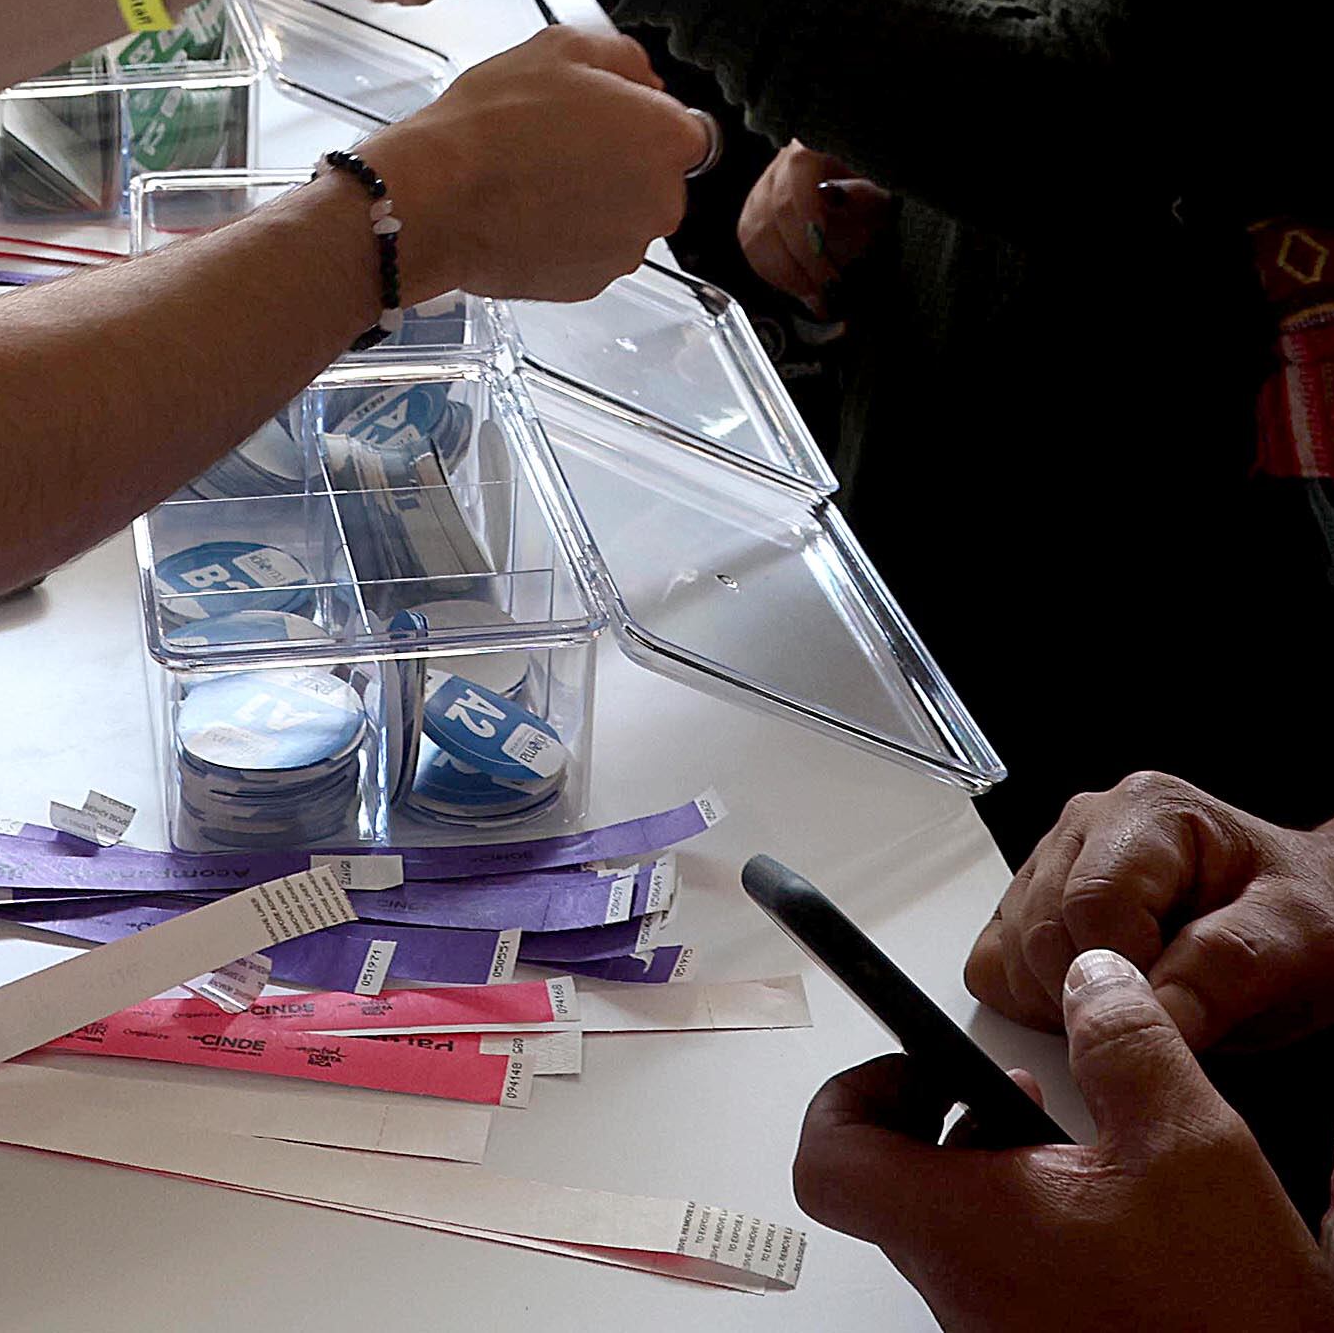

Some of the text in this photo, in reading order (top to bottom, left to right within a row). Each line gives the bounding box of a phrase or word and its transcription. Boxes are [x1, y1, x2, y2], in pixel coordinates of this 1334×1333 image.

[444, 688, 507, 738] A2
[361, 949, 383, 987] 051971
[492, 939, 511, 978] 050551
[250, 1002, 315, 1016] CINDE
[551, 984, 568, 1014] 094168
[203, 1033, 267, 1052] CINDE
[505, 1062, 523, 1099] 094148
[695, 1209, 712, 1235] EXPOSE
[728, 1217, 744, 1243] EXPOSE
[694, 1234, 704, 1244] TO
[727, 1243, 737, 1253] TO
[761, 1227, 778, 1253] EXPOSE
[760, 1252, 770, 1262] TO
